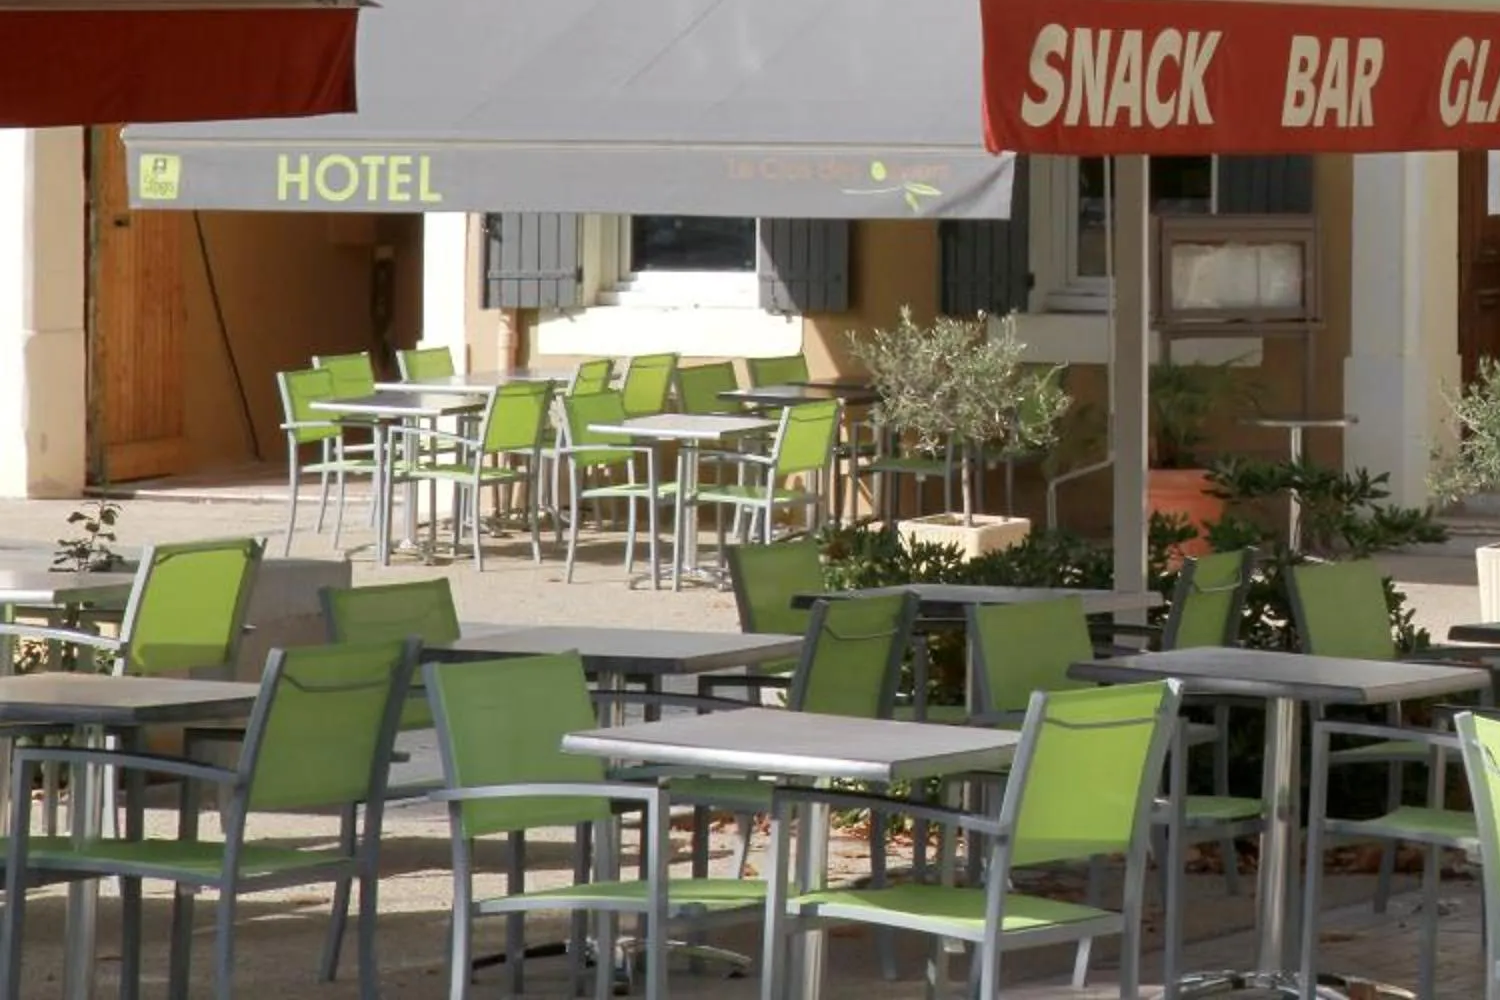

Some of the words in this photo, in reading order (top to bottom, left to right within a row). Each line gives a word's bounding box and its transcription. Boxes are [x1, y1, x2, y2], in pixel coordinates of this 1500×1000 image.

[1020, 23, 1222, 128] SNACK
[1281, 35, 1384, 127] BAR
[277, 154, 442, 202] HOTEL
